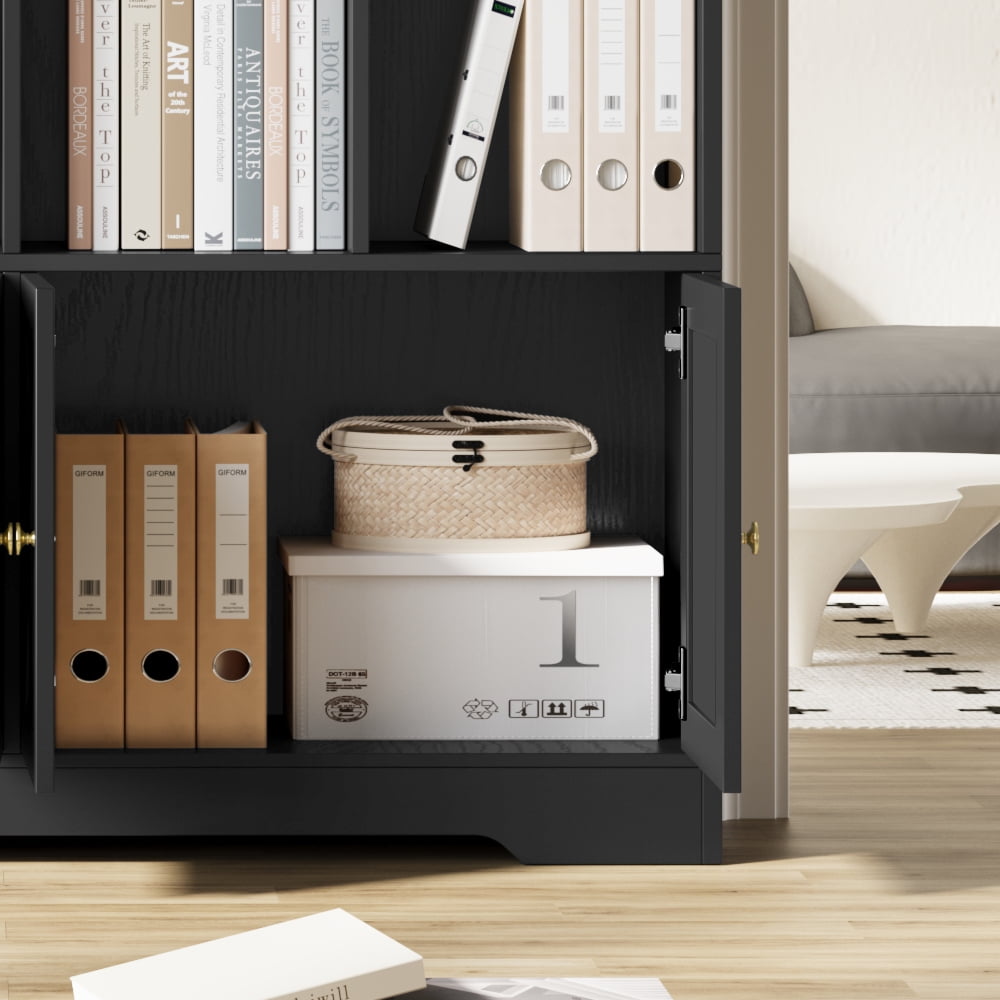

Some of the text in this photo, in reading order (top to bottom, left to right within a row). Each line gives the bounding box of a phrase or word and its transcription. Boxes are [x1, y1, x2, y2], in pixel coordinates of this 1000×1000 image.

[320, 18, 330, 37] THE
[100, 67, 110, 113] the
[141, 61, 150, 91] Knitting
[167, 41, 190, 84] ART
[296, 67, 306, 113] the
[321, 41, 340, 95] BOOK
[165, 107, 191, 116] Century
[214, 4, 226, 182] Detail Contemporary Residential Architecture
[243, 47, 261, 180] ANTIQUAIRES
[72, 87, 87, 157] BORDEAUX
[268, 86, 283, 157] BORDEAUX
[98, 129, 112, 184] Top
[294, 129, 308, 184] Top
[321, 116, 340, 212] SYMBOLS
[539, 589, 600, 668] 1
